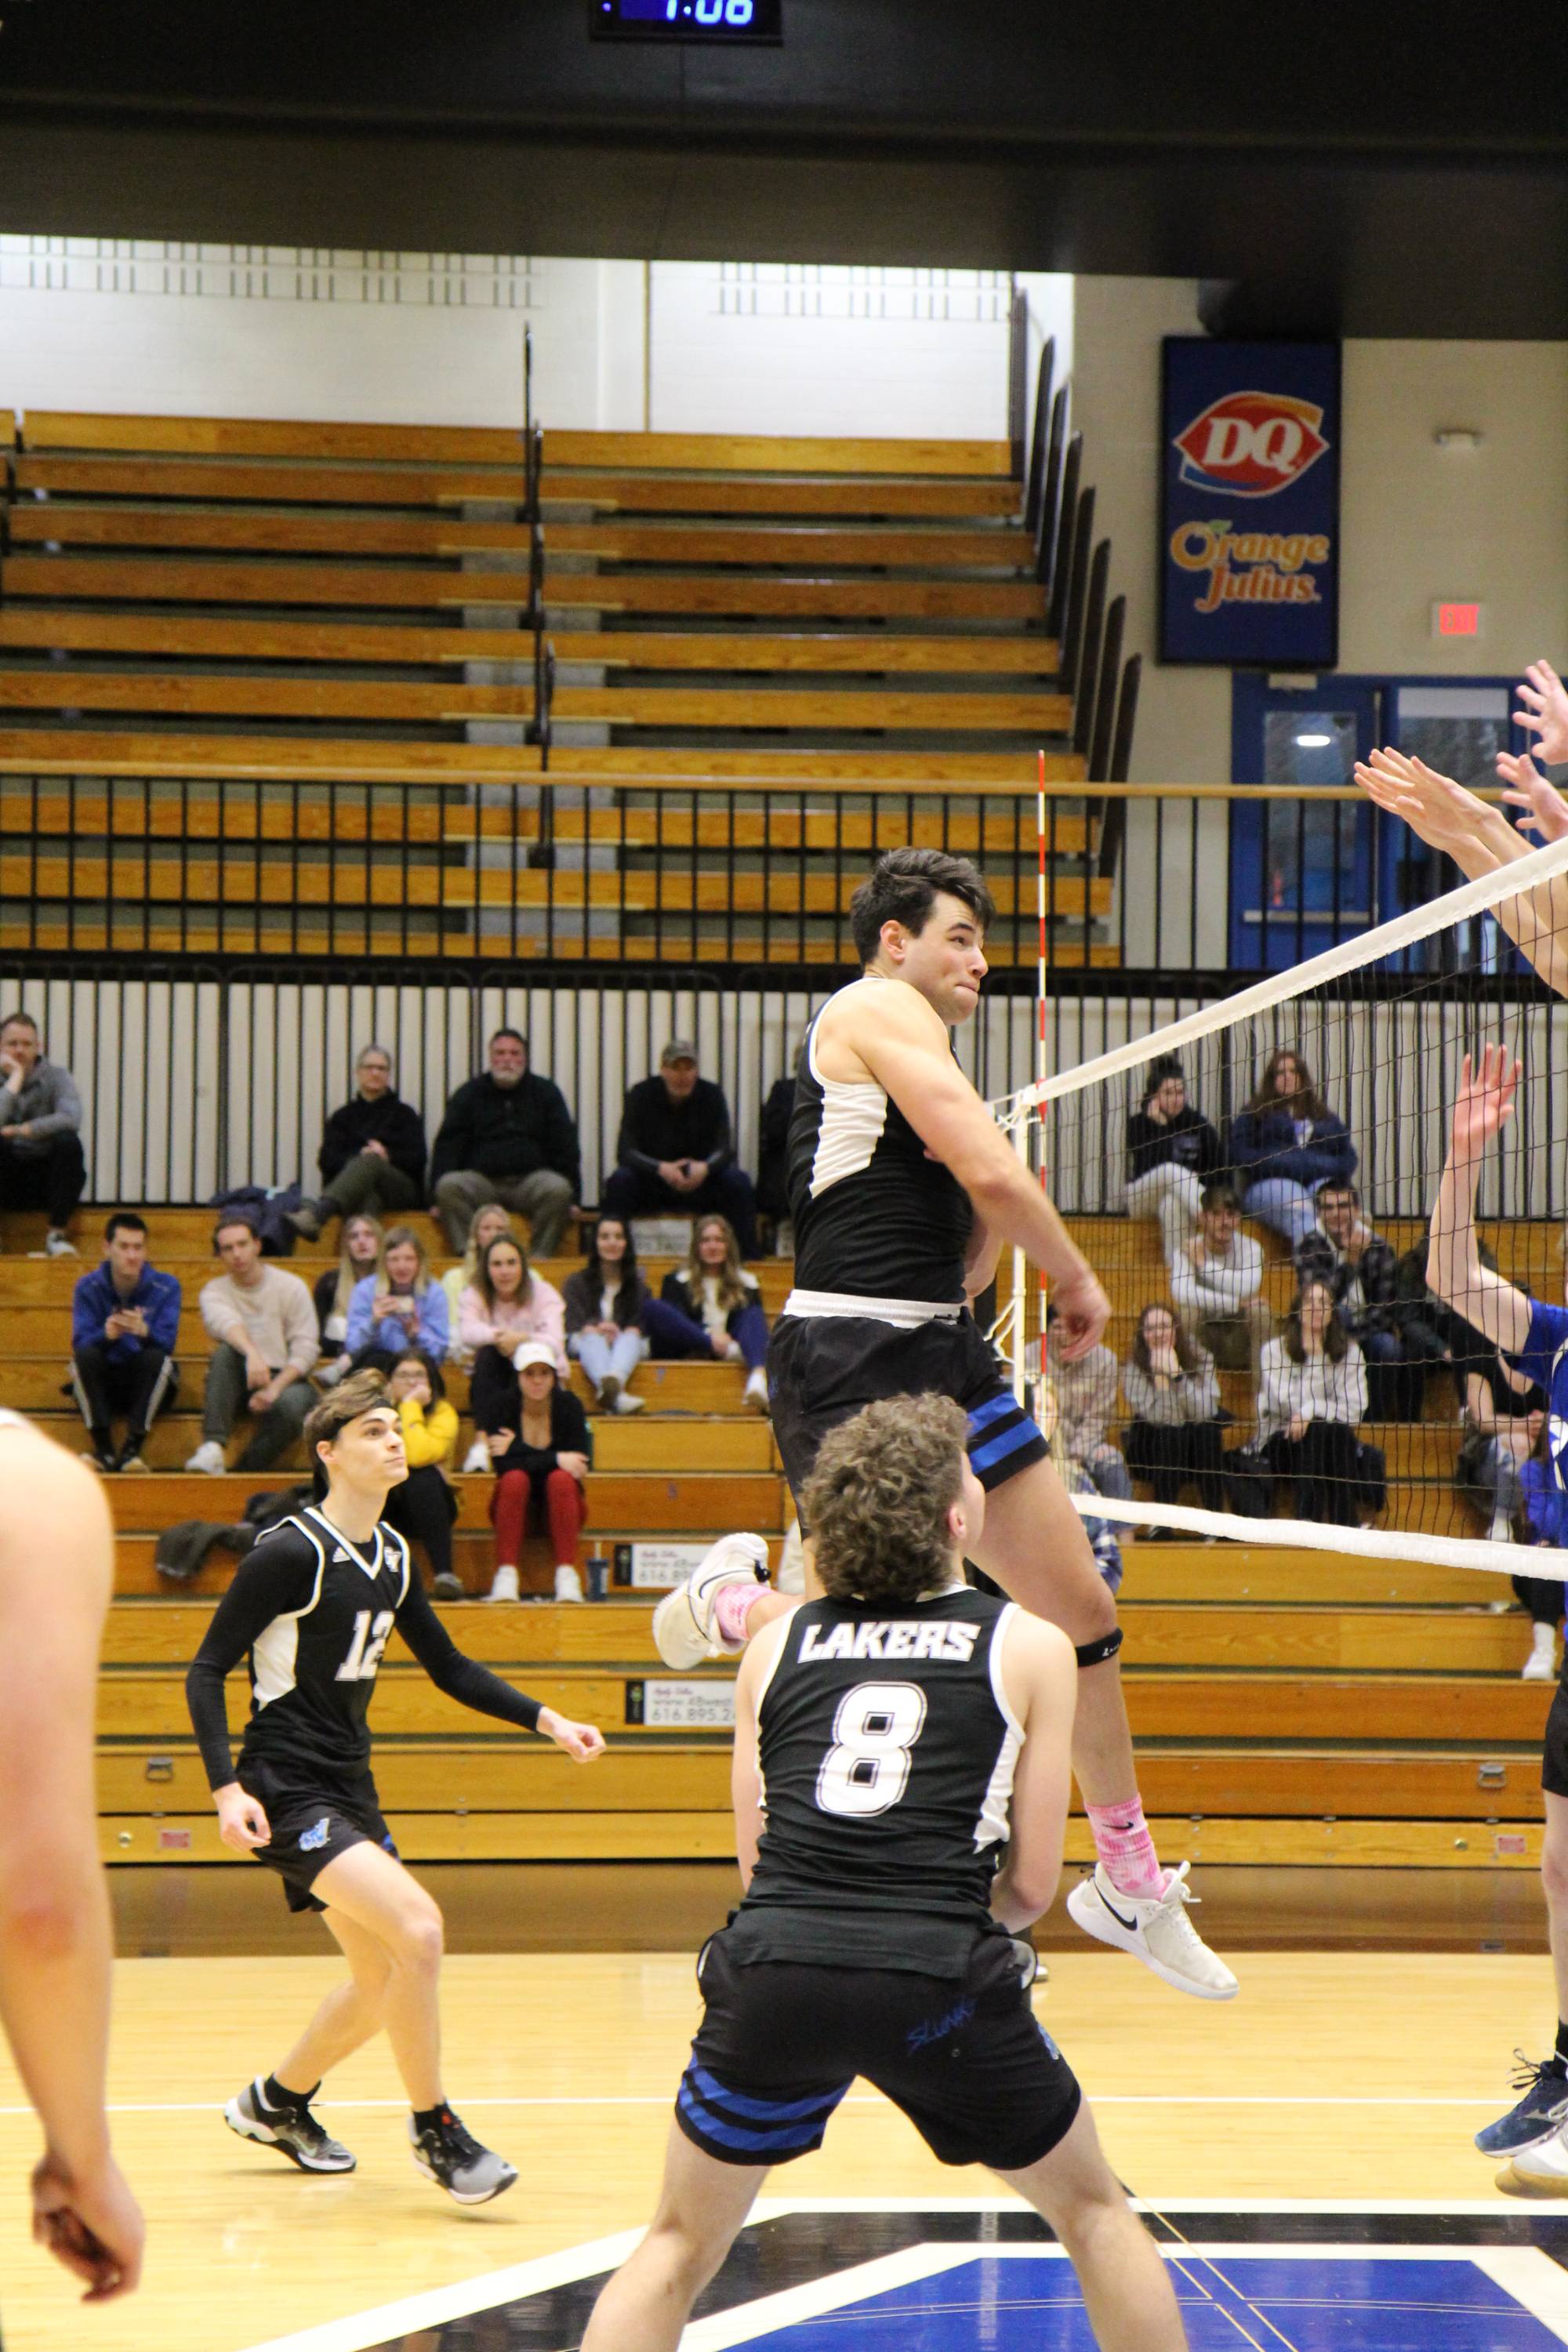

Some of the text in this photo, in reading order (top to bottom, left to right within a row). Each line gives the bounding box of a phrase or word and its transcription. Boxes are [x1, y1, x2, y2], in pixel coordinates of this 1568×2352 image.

[1202, 416, 1303, 474] DQ
[1170, 520, 1330, 572] Orange
[1194, 564, 1317, 614] Julius
[335, 1610, 395, 1681] 12
[797, 1620, 982, 1663] LAKERS
[815, 1680, 927, 1817] 8
